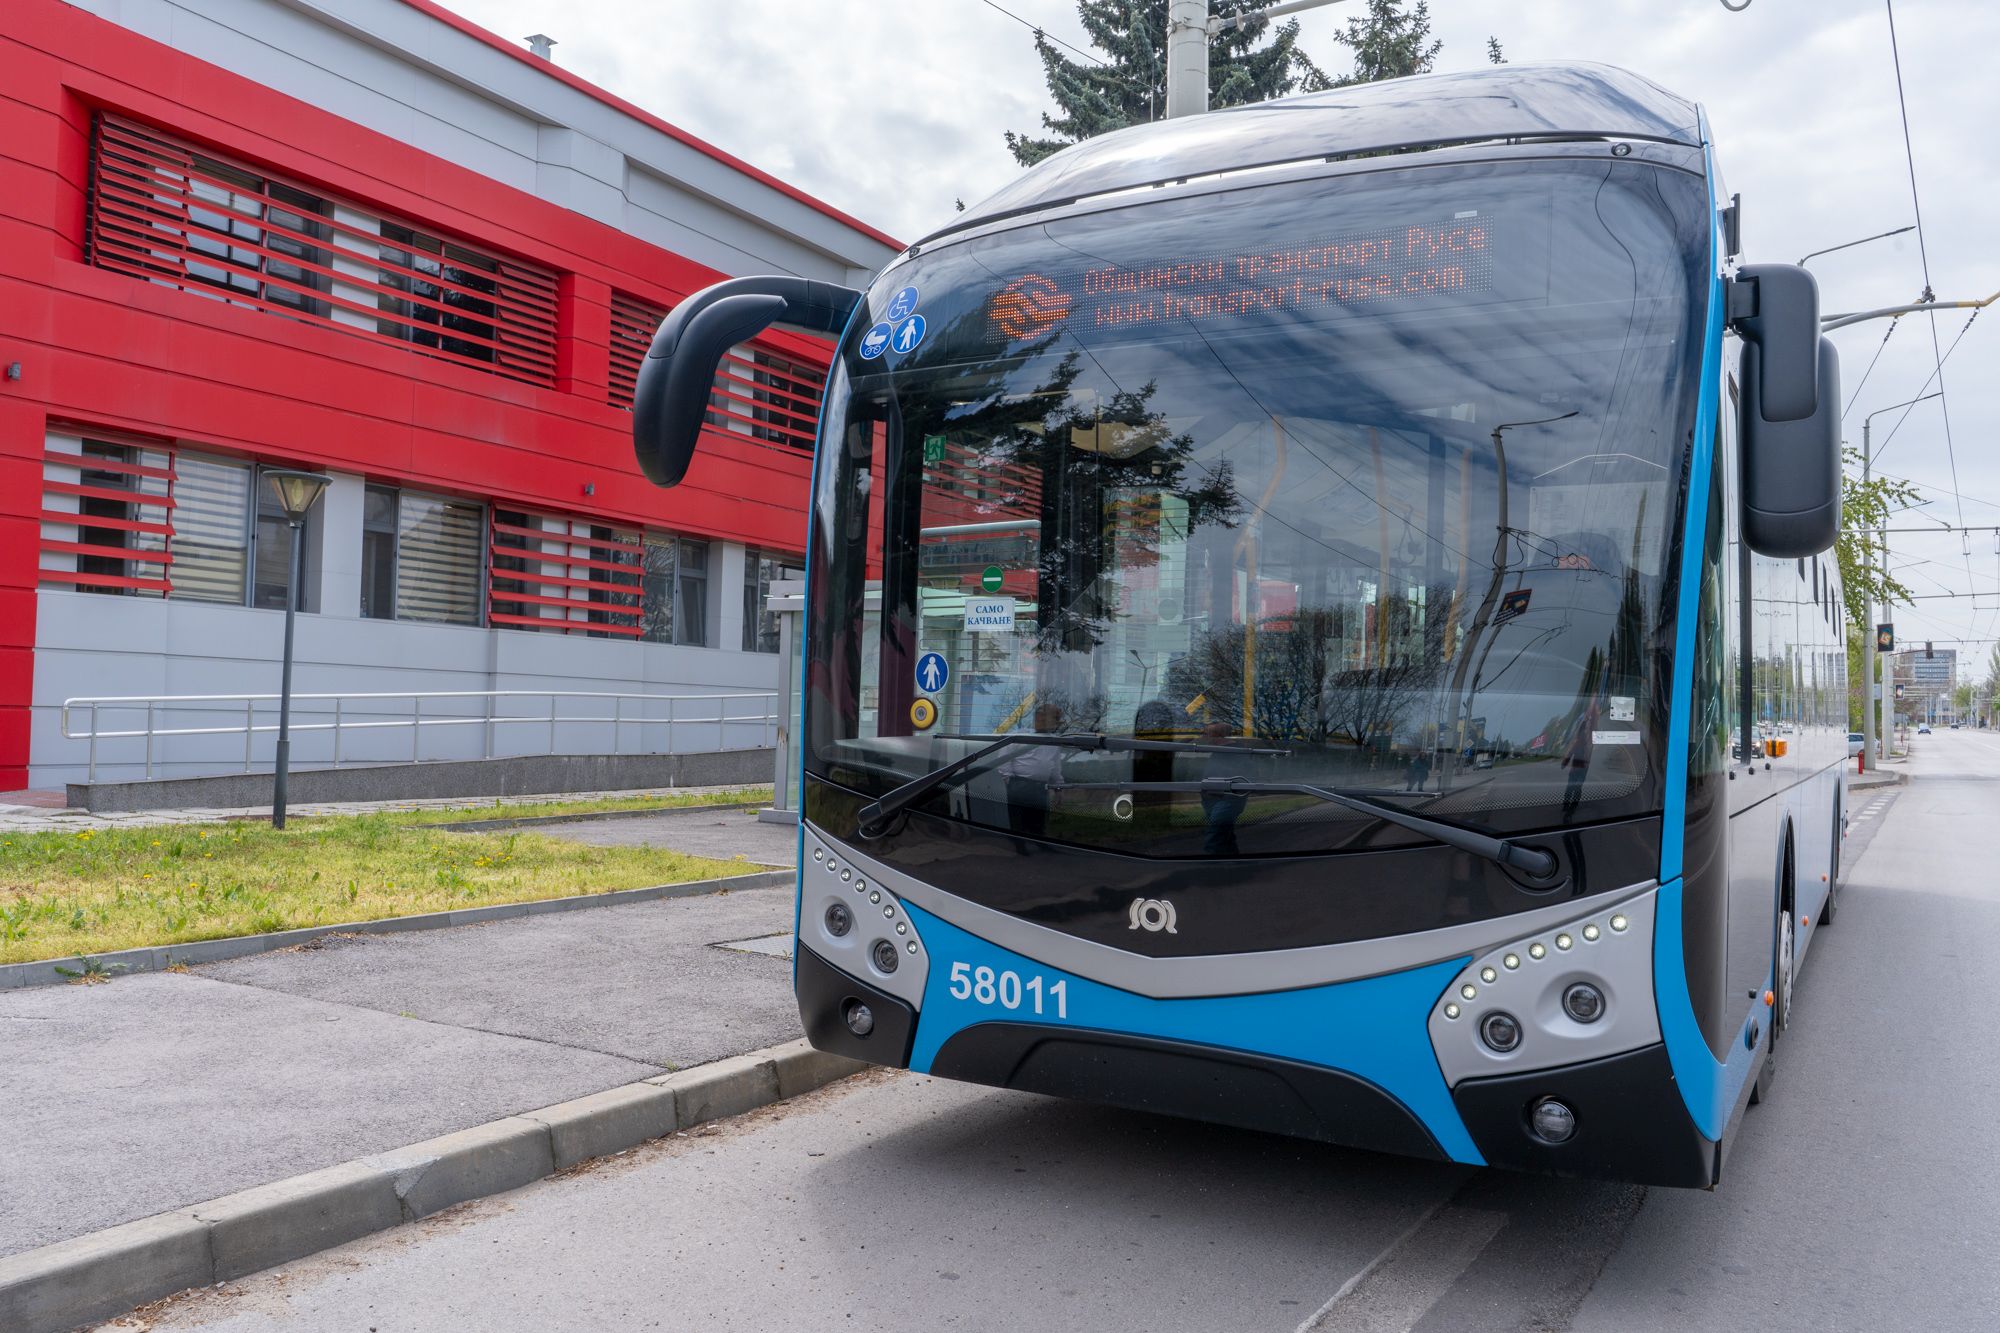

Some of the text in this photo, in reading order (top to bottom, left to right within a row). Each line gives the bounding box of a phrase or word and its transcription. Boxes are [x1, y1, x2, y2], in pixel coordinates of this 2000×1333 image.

[1084, 226, 1486, 296] Общински транспорт Русе
[1096, 266, 1464, 326] www.transport-ruse.com
[967, 616, 1012, 625] КАЧВАНЕ
[975, 604, 1004, 614] САМО
[949, 961, 1067, 1019] 58011
